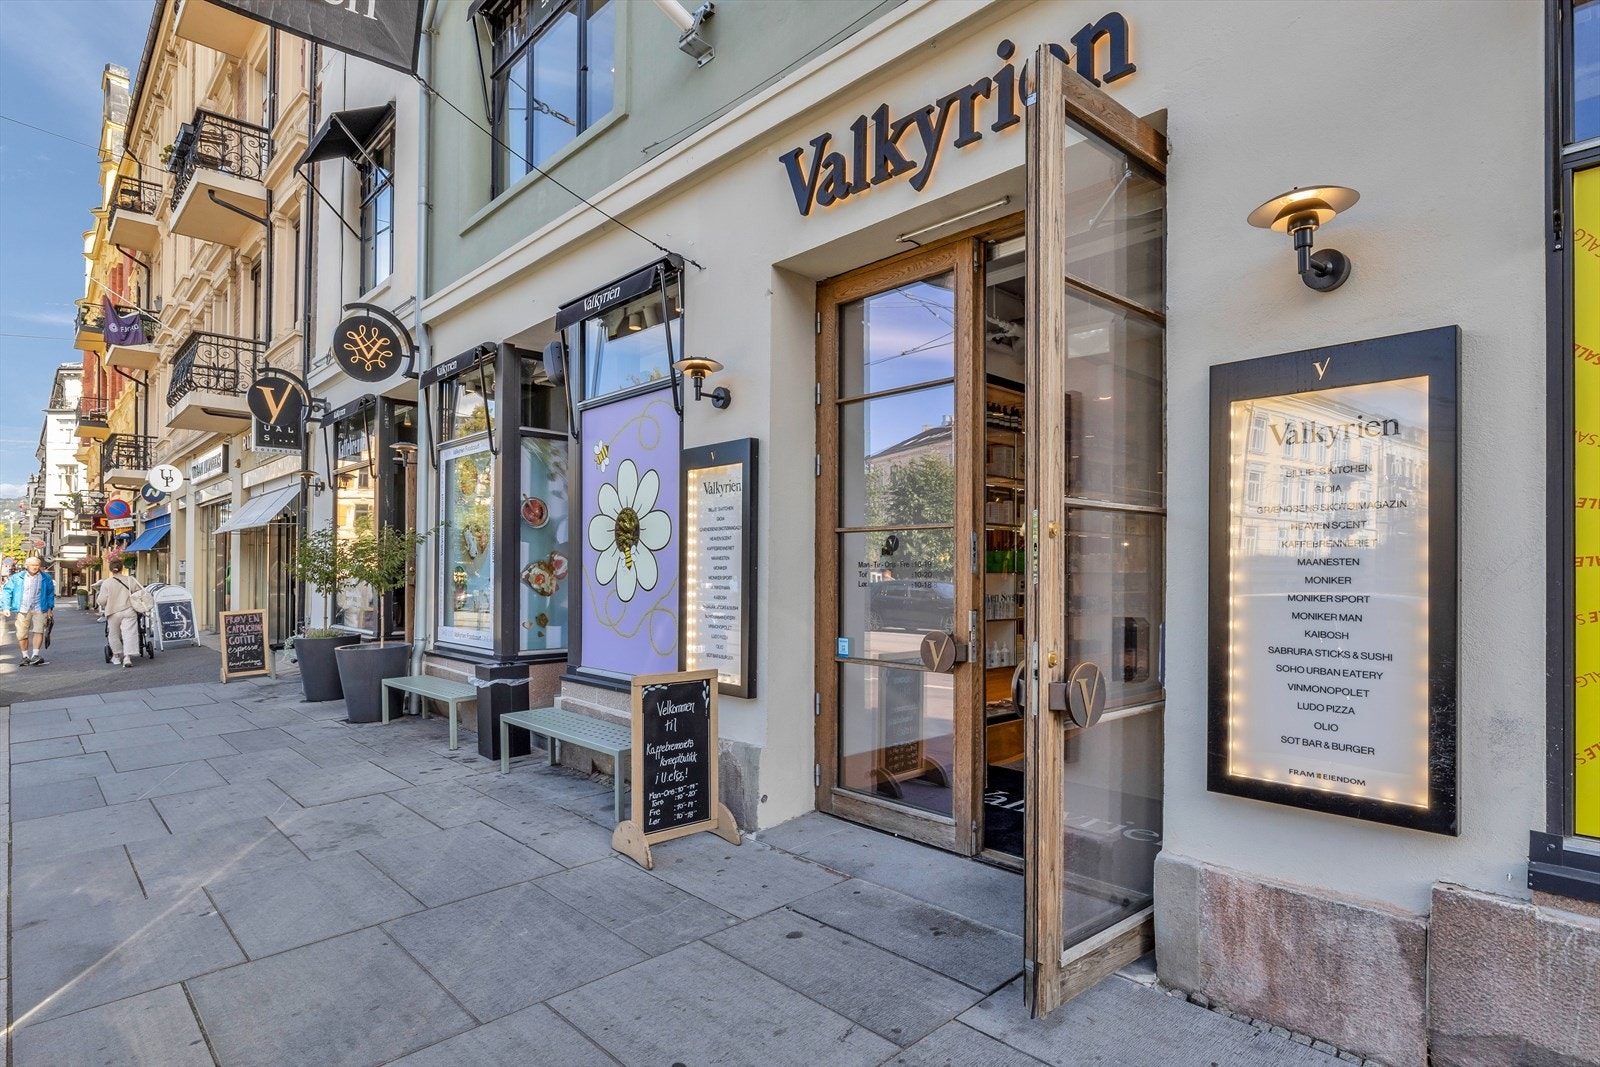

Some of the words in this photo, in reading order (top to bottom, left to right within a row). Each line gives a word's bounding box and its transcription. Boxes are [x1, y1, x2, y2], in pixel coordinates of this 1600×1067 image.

[779, 11, 1136, 217] Valkyrin
[584, 286, 621, 312] Valkyrien
[1269, 414, 1401, 449] Valkyrien
[1328, 464, 1373, 475] KITCHEN
[703, 479, 742, 498] Valkyrien
[1314, 484, 1342, 494] GIOIA
[1291, 521, 1330, 531] HEAVEN
[1331, 520, 1368, 530] SCENT
[1281, 538, 1378, 549] KAFFEBRENNERIET
[1297, 557, 1360, 566] MAANESTEN
[1304, 576, 1352, 585] MONIKER
[1287, 594, 1334, 603] MONIKER
[1334, 595, 1370, 604] SPORT
[1291, 612, 1338, 621] MONIKER
[1338, 614, 1363, 622] MAN
[1304, 630, 1349, 640] KAIBOSH
[1268, 646, 1314, 657] SABRURA
[1314, 649, 1351, 659] STICKS
[1352, 651, 1359, 660] &
[1360, 652, 1393, 662] SUSHI
[1275, 664, 1305, 674] SOHO
[1306, 667, 1341, 677] URBAN
[1342, 669, 1384, 680] EATERY
[1287, 683, 1370, 698] VINMONOPOLET
[656, 700, 696, 717] Velkommen
[1297, 702, 1325, 712] LUDO
[1326, 704, 1356, 715] PIZZA
[664, 718, 677, 733] til
[1313, 721, 1339, 732] OLIO
[1280, 735, 1301, 746] SOT
[1302, 738, 1323, 748] BAR
[1323, 741, 1330, 750] &
[1331, 743, 1376, 756] BURGER
[1288, 768, 1315, 778] FRAM
[1322, 773, 1367, 787] EIENDOM
